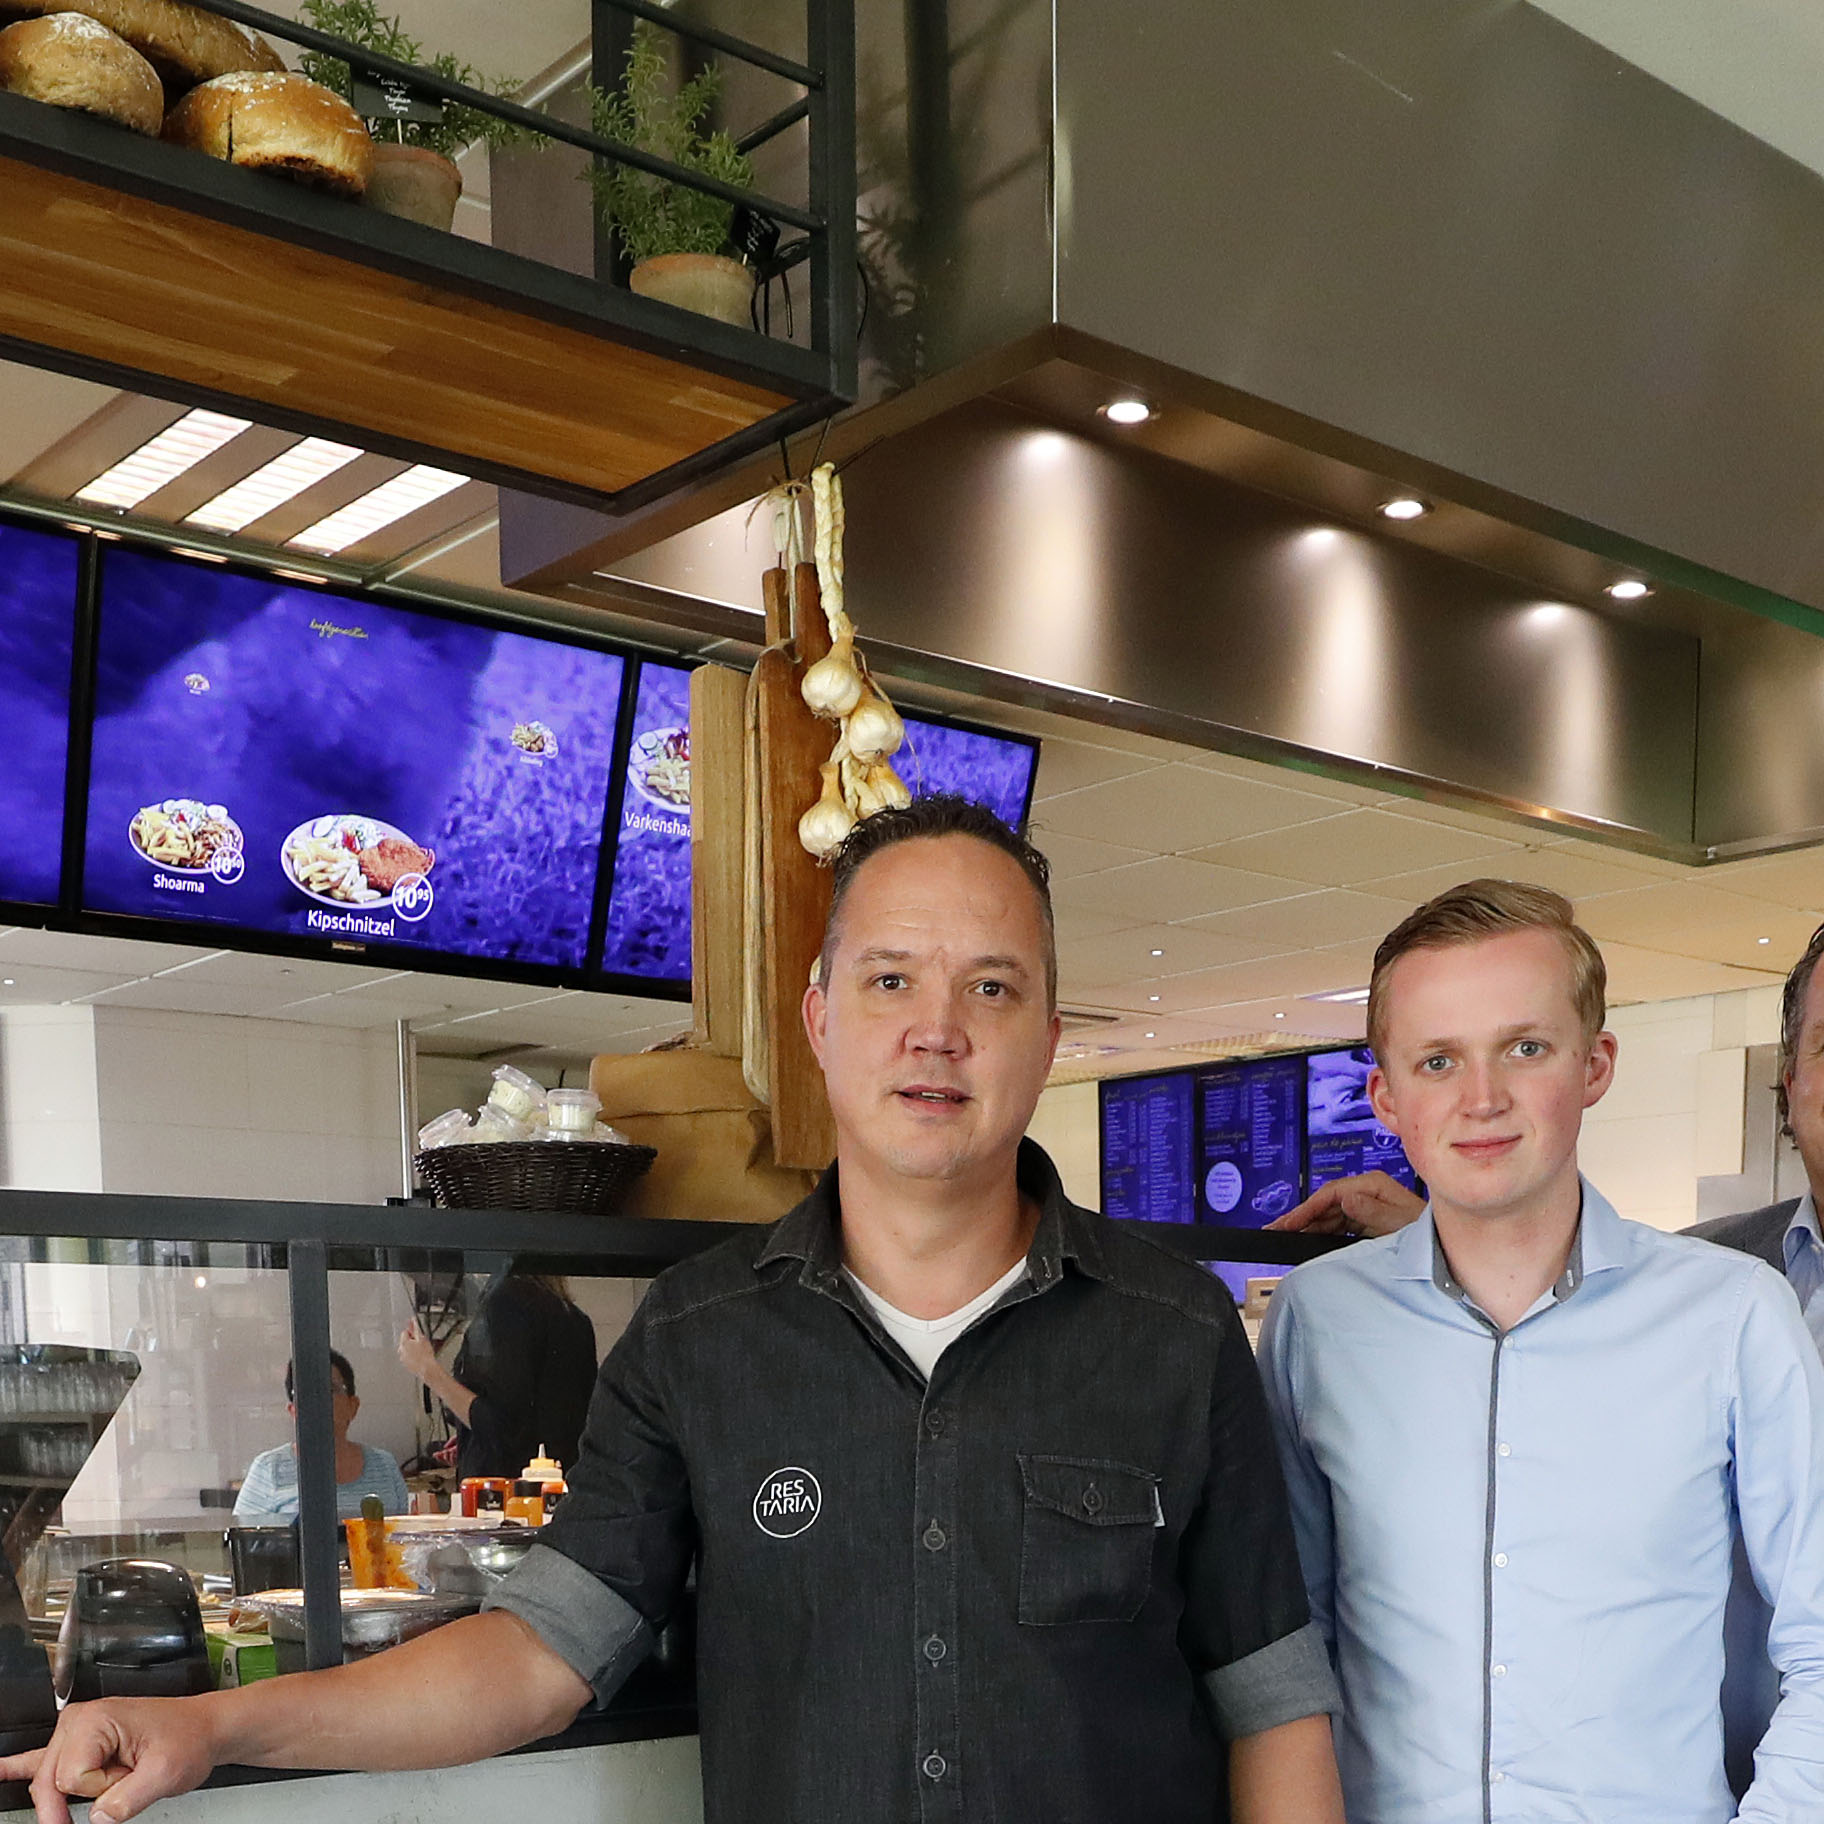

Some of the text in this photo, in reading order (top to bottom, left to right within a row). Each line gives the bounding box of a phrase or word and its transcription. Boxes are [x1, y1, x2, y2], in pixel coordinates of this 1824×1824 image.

[153, 873, 205, 893] Shoarma
[307, 909, 395, 937] Kipschnitzel
[770, 1479, 805, 1500] RES
[759, 1495, 815, 1517] TARIA
